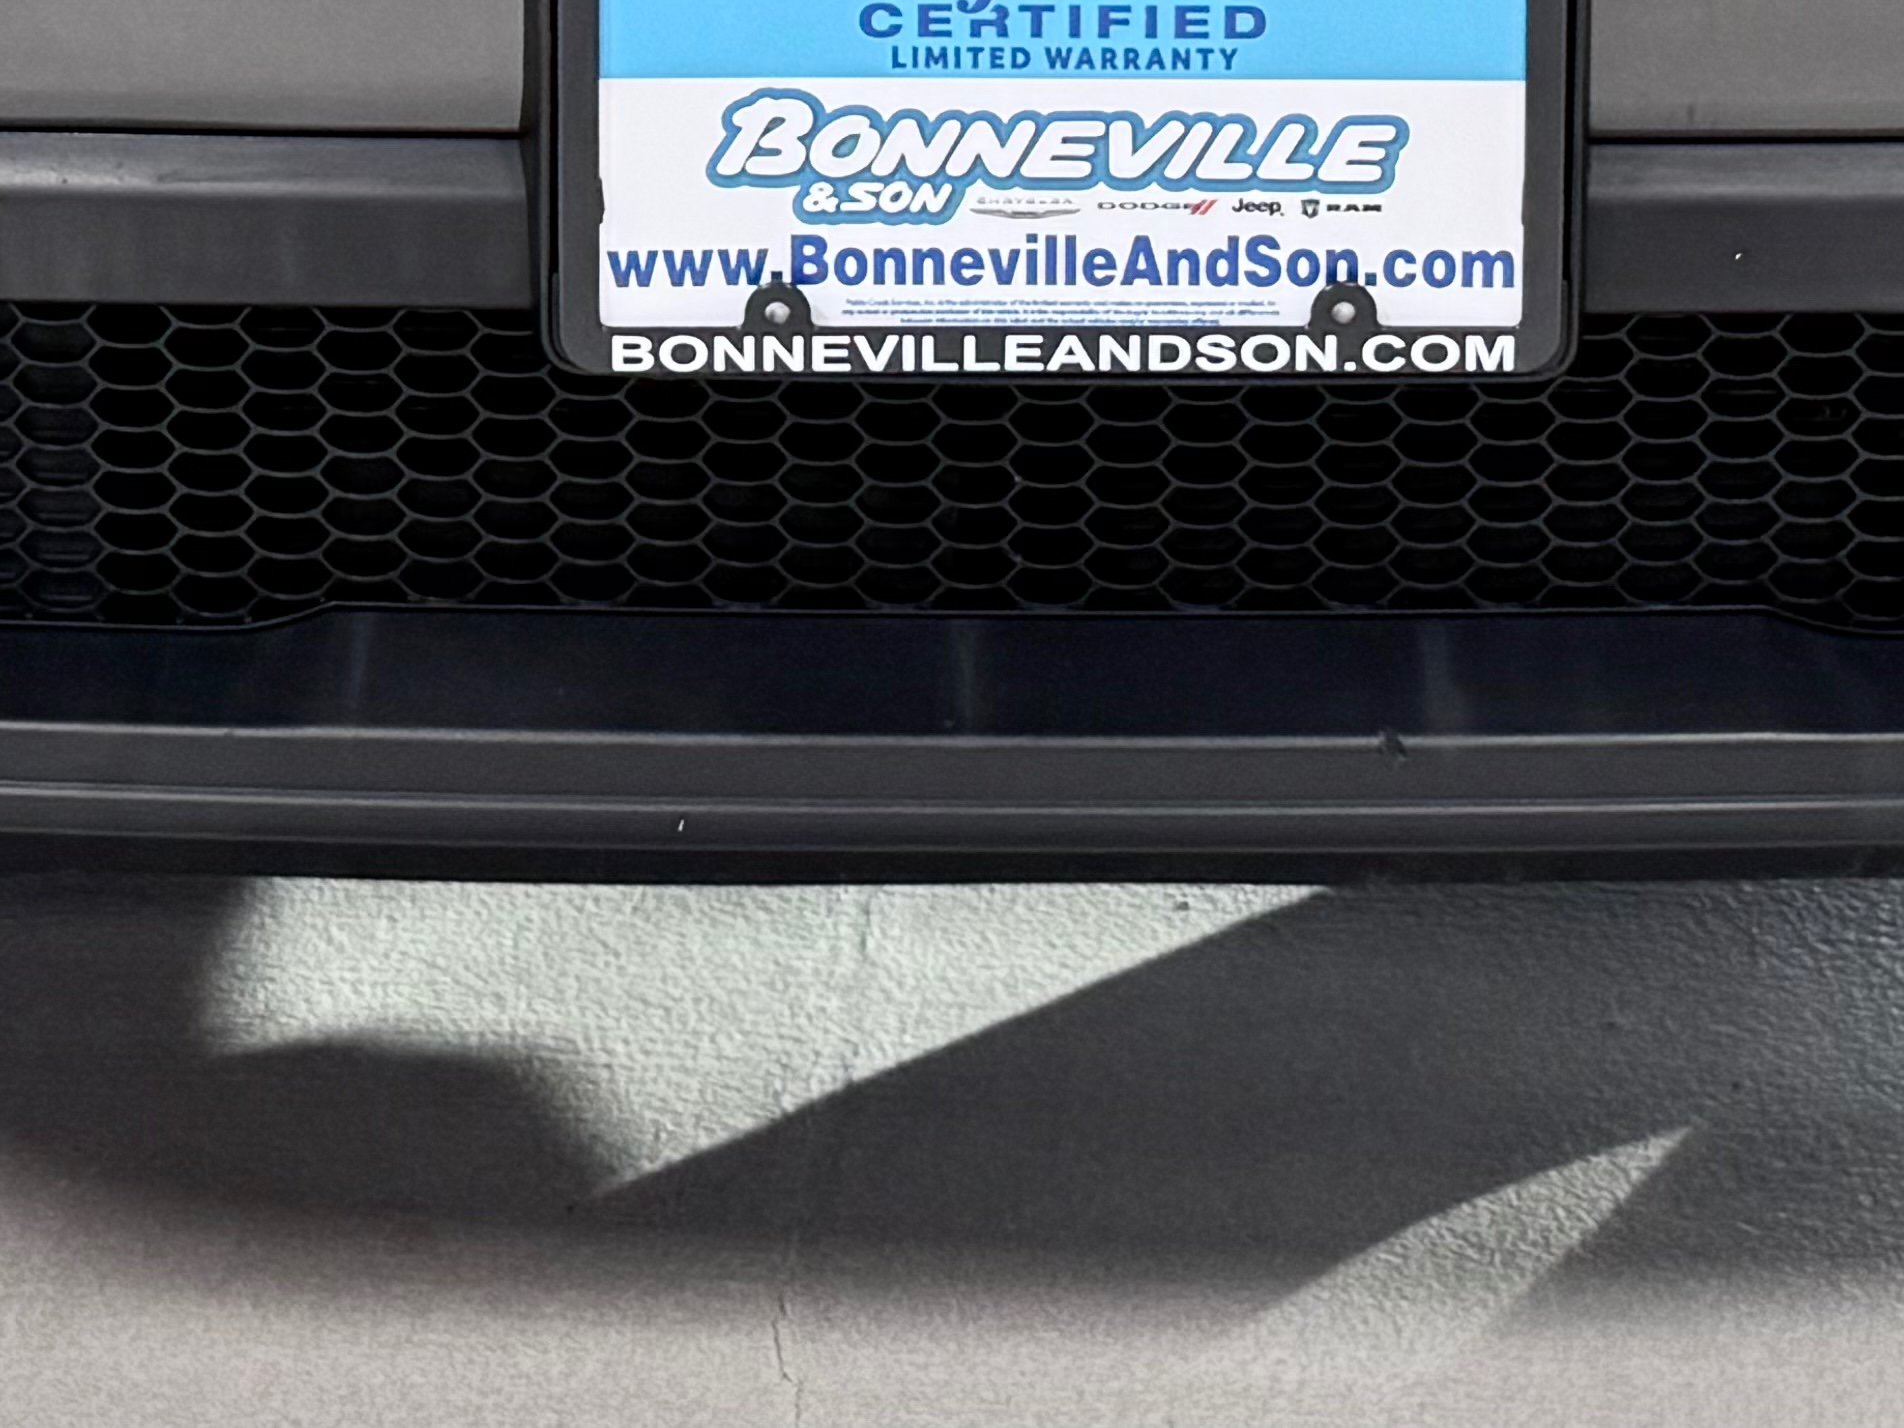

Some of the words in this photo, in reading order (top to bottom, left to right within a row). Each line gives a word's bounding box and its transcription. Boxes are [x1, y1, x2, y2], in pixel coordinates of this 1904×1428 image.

[858, 2, 1267, 40] CERTIFIED
[891, 45, 1032, 70] LIMITED
[1044, 46, 1239, 71] WARRANTY
[712, 93, 1401, 185] BONNEVILLE
[606, 233, 1516, 288] www.BonnevilleAndSon.com
[610, 334, 1516, 373] BONNEVILLEANDSON.COM
